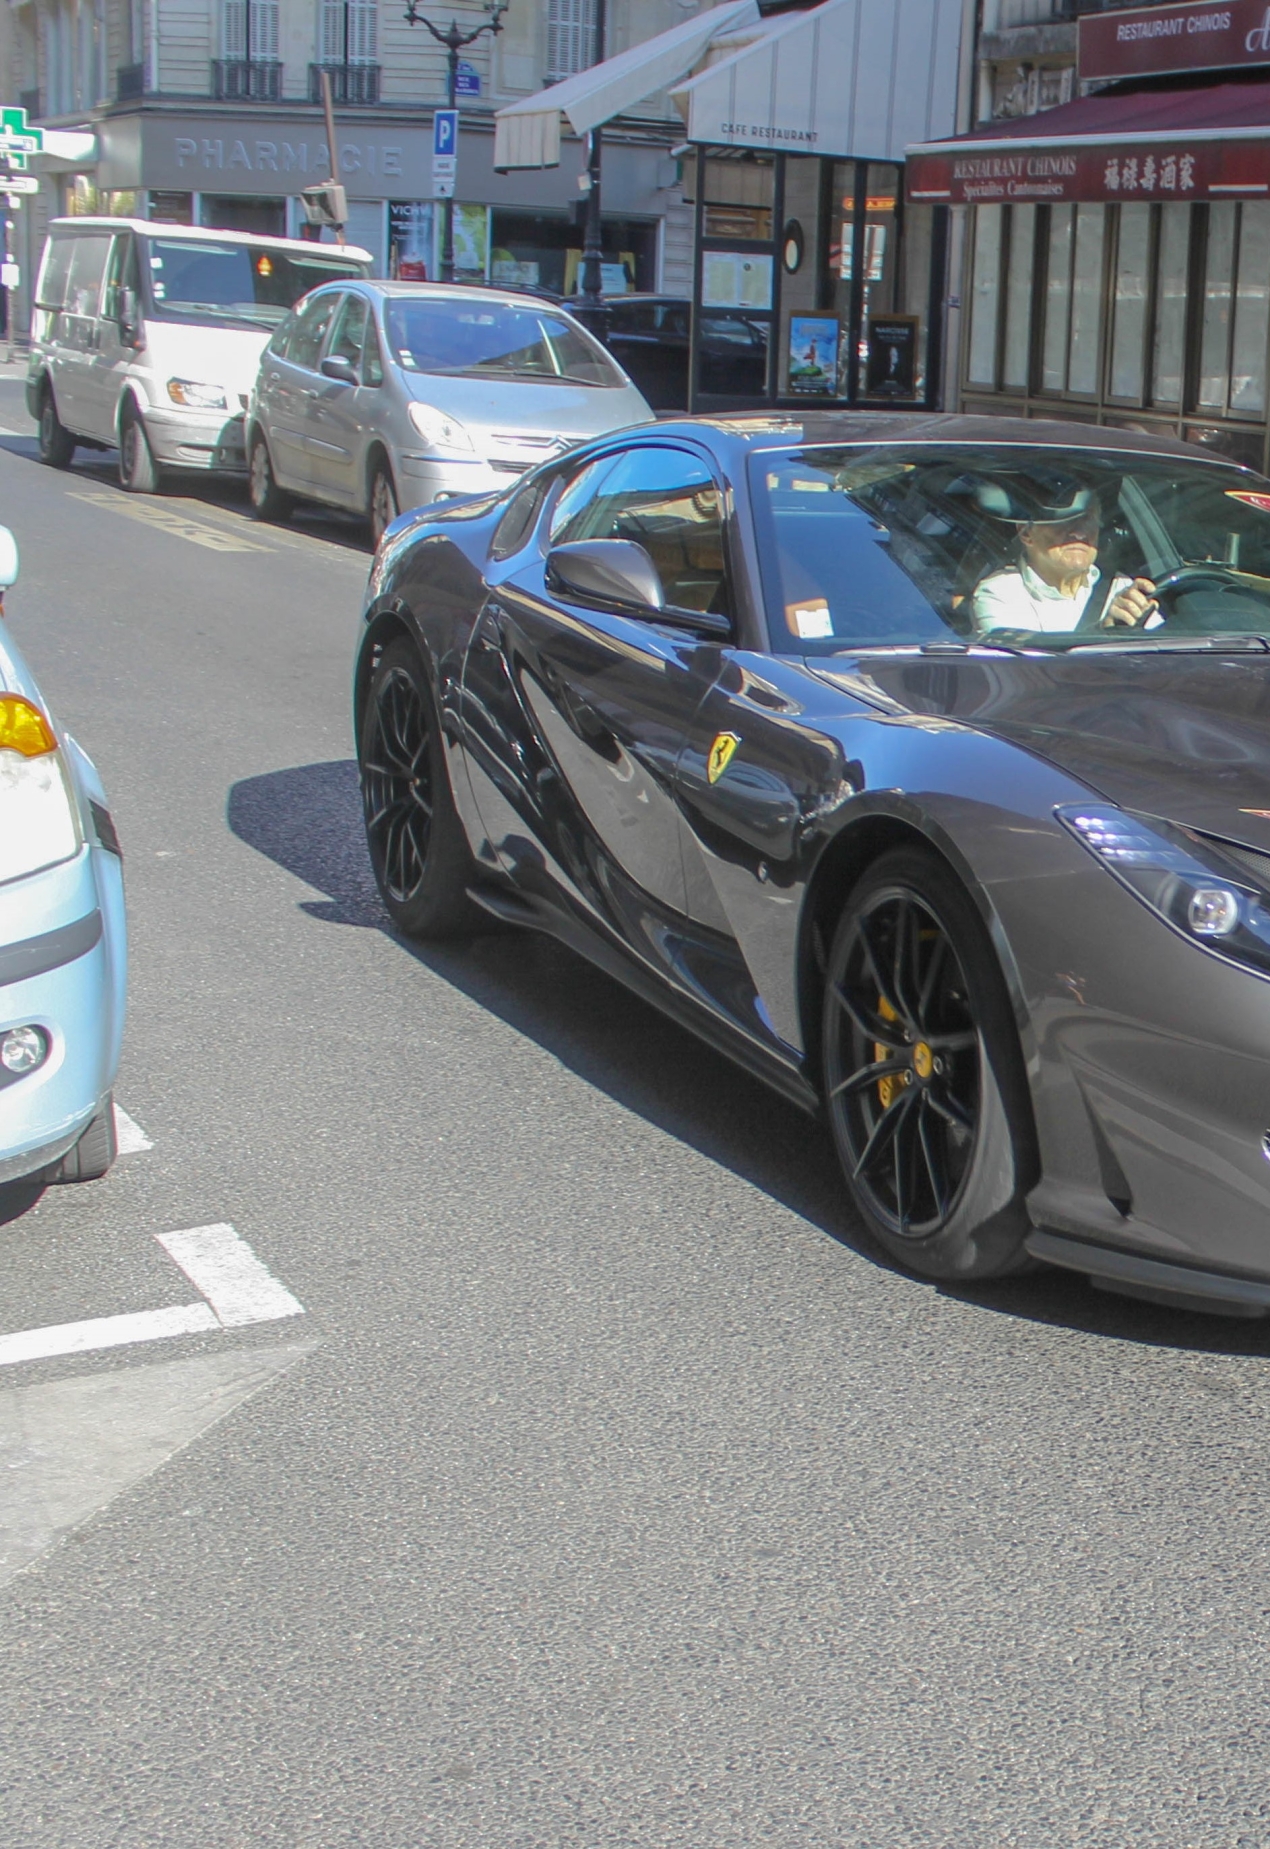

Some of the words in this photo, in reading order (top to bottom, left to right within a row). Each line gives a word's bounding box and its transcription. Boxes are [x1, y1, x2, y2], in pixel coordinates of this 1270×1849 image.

[1117, 18, 1186, 41] RESTAURANT
[1187, 12, 1231, 33] CHINOIS
[439, 119, 451, 148] P
[751, 126, 818, 142] RESTAURANT
[175, 138, 403, 177] PHARMACIE
[954, 158, 1024, 178] RESTAURANT
[1027, 155, 1077, 176] CHINOIS
